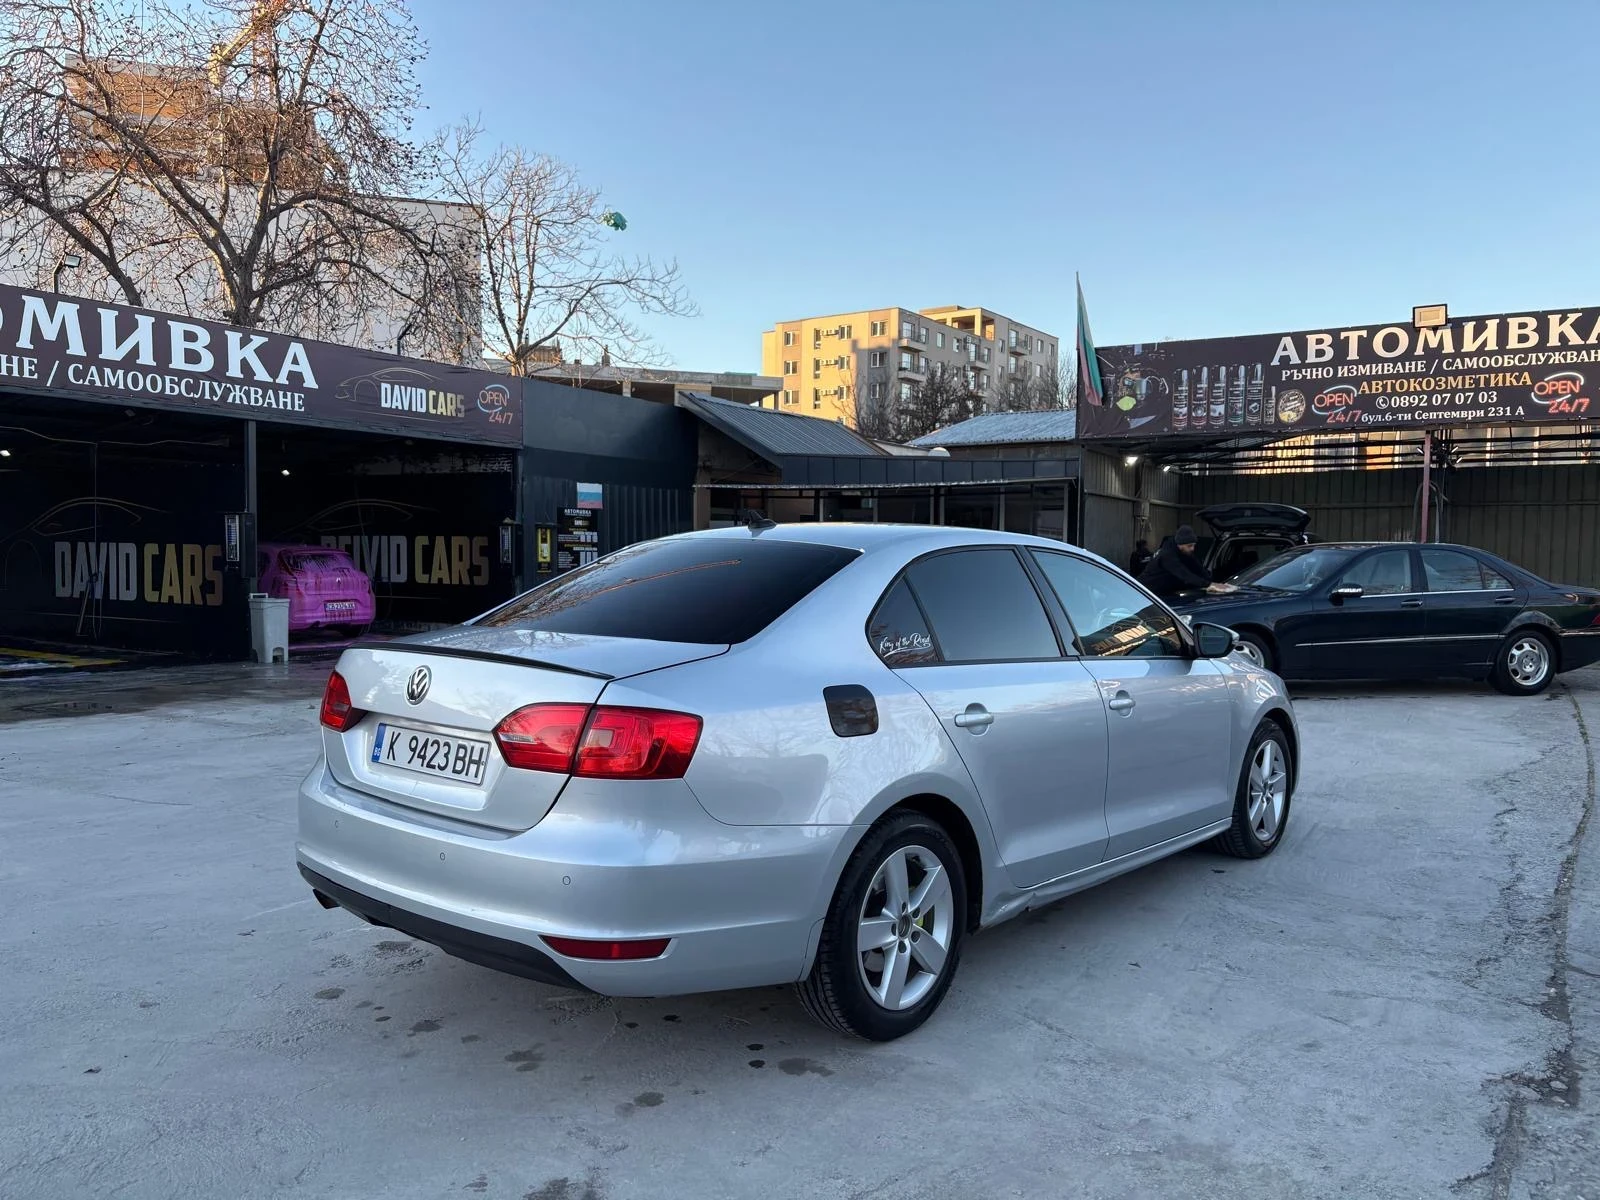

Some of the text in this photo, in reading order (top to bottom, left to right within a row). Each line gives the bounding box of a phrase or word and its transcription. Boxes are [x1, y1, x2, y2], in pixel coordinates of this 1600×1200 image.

[0, 295, 319, 389] МИВКА
[1281, 366, 1334, 381] РЪЧНО
[1337, 360, 1426, 378] ИЗМИВАНЕ
[67, 363, 305, 412] САМООБСЛУЖВАНЕ
[1358, 371, 1532, 395] АВТОКОЗМЕТИКА
[1534, 380, 1580, 395] OPEN
[380, 382, 465, 418] DAVID CARS
[479, 389, 507, 407] OPEN
[1314, 392, 1353, 408] OPEN
[1391, 391, 1498, 408] 0892 07 07 03
[1548, 398, 1590, 414] 24/7
[488, 410, 513, 425] 24/7
[1327, 410, 1362, 423] 24/7
[1414, 409, 1485, 421] Септември
[1487, 406, 1512, 417] 231
[414, 535, 490, 586] CARS
[54, 541, 223, 607] DAVID CARS
[386, 731, 484, 778] K 9423 BH
